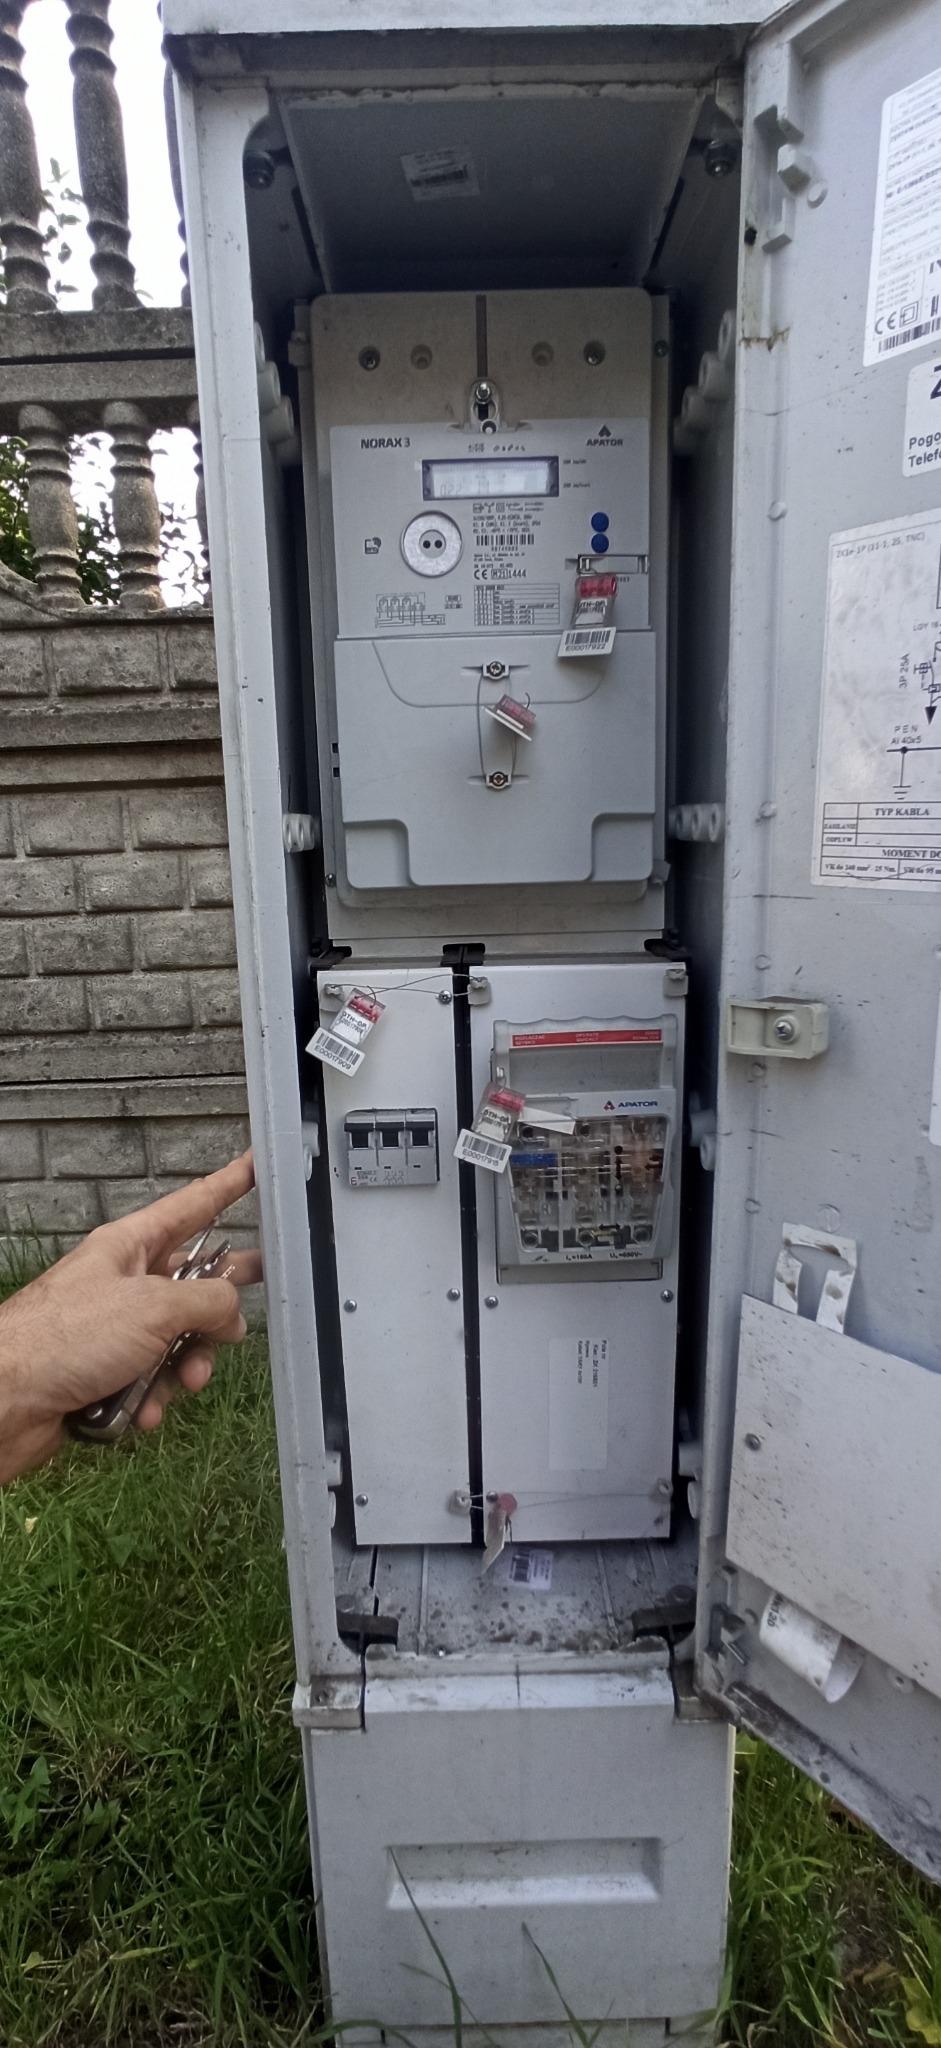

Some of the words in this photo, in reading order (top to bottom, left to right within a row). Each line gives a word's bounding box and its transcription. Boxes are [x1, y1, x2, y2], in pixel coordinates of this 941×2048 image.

[361, 438, 402, 449] NORAX
[404, 438, 410, 448] 3
[508, 569, 526, 578] 1444
[565, 644, 606, 652] E00017922
[900, 653, 910, 674] 25A
[901, 735, 922, 744] 40x5
[874, 808, 894, 816] TYP
[895, 808, 930, 816] KABLA
[882, 849, 928, 858] MOMENT
[314, 1045, 352, 1069] E00017909
